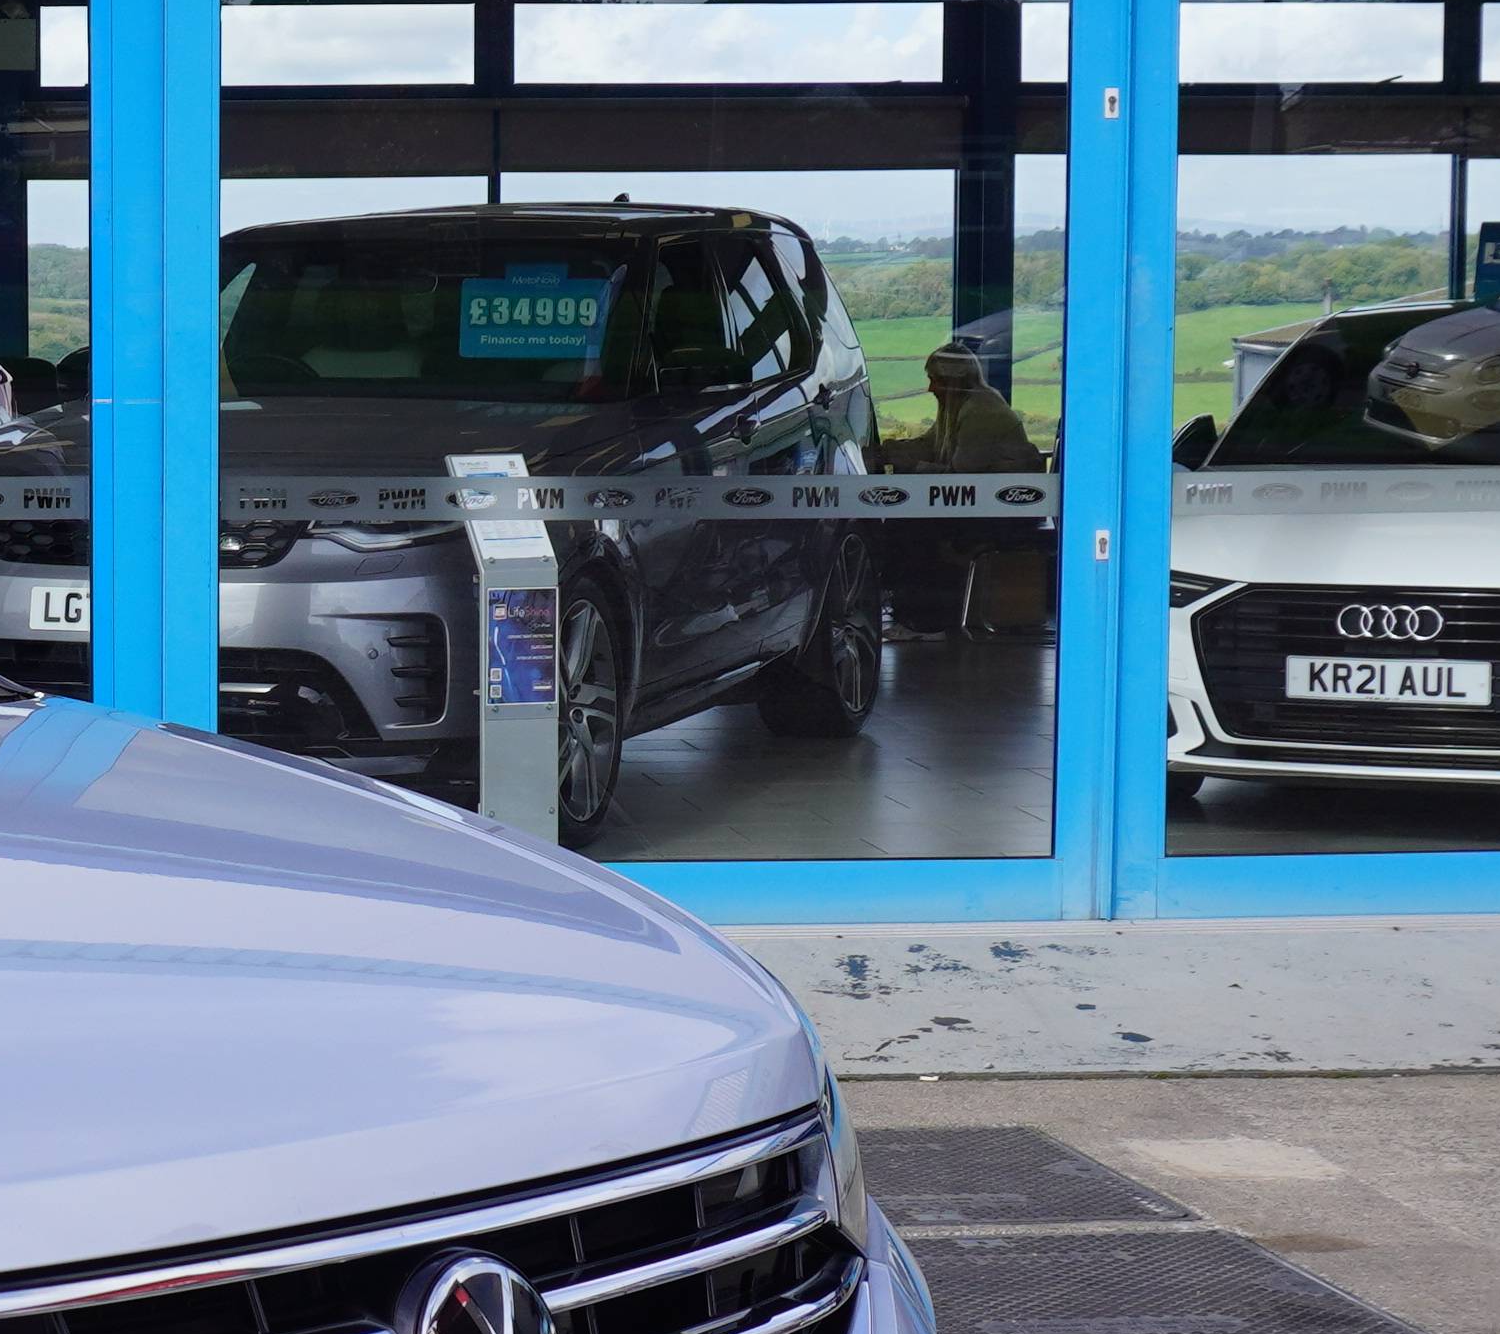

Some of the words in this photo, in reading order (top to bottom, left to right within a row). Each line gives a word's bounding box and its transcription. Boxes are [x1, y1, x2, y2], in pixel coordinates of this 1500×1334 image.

[469, 297, 598, 326] £34999
[480, 334, 525, 345] Finance
[528, 336, 546, 345] me
[549, 334, 586, 347] today!
[23, 487, 72, 509] PWM
[377, 487, 426, 510] PWM
[516, 487, 565, 510] PWM
[792, 486, 840, 508] PWM
[929, 485, 976, 507] PWM
[1185, 482, 1233, 506] PWM
[1319, 480, 1368, 505] PWM
[44, 591, 90, 623] LG
[1309, 661, 1386, 695] KR21
[1398, 665, 1467, 698] AUL
